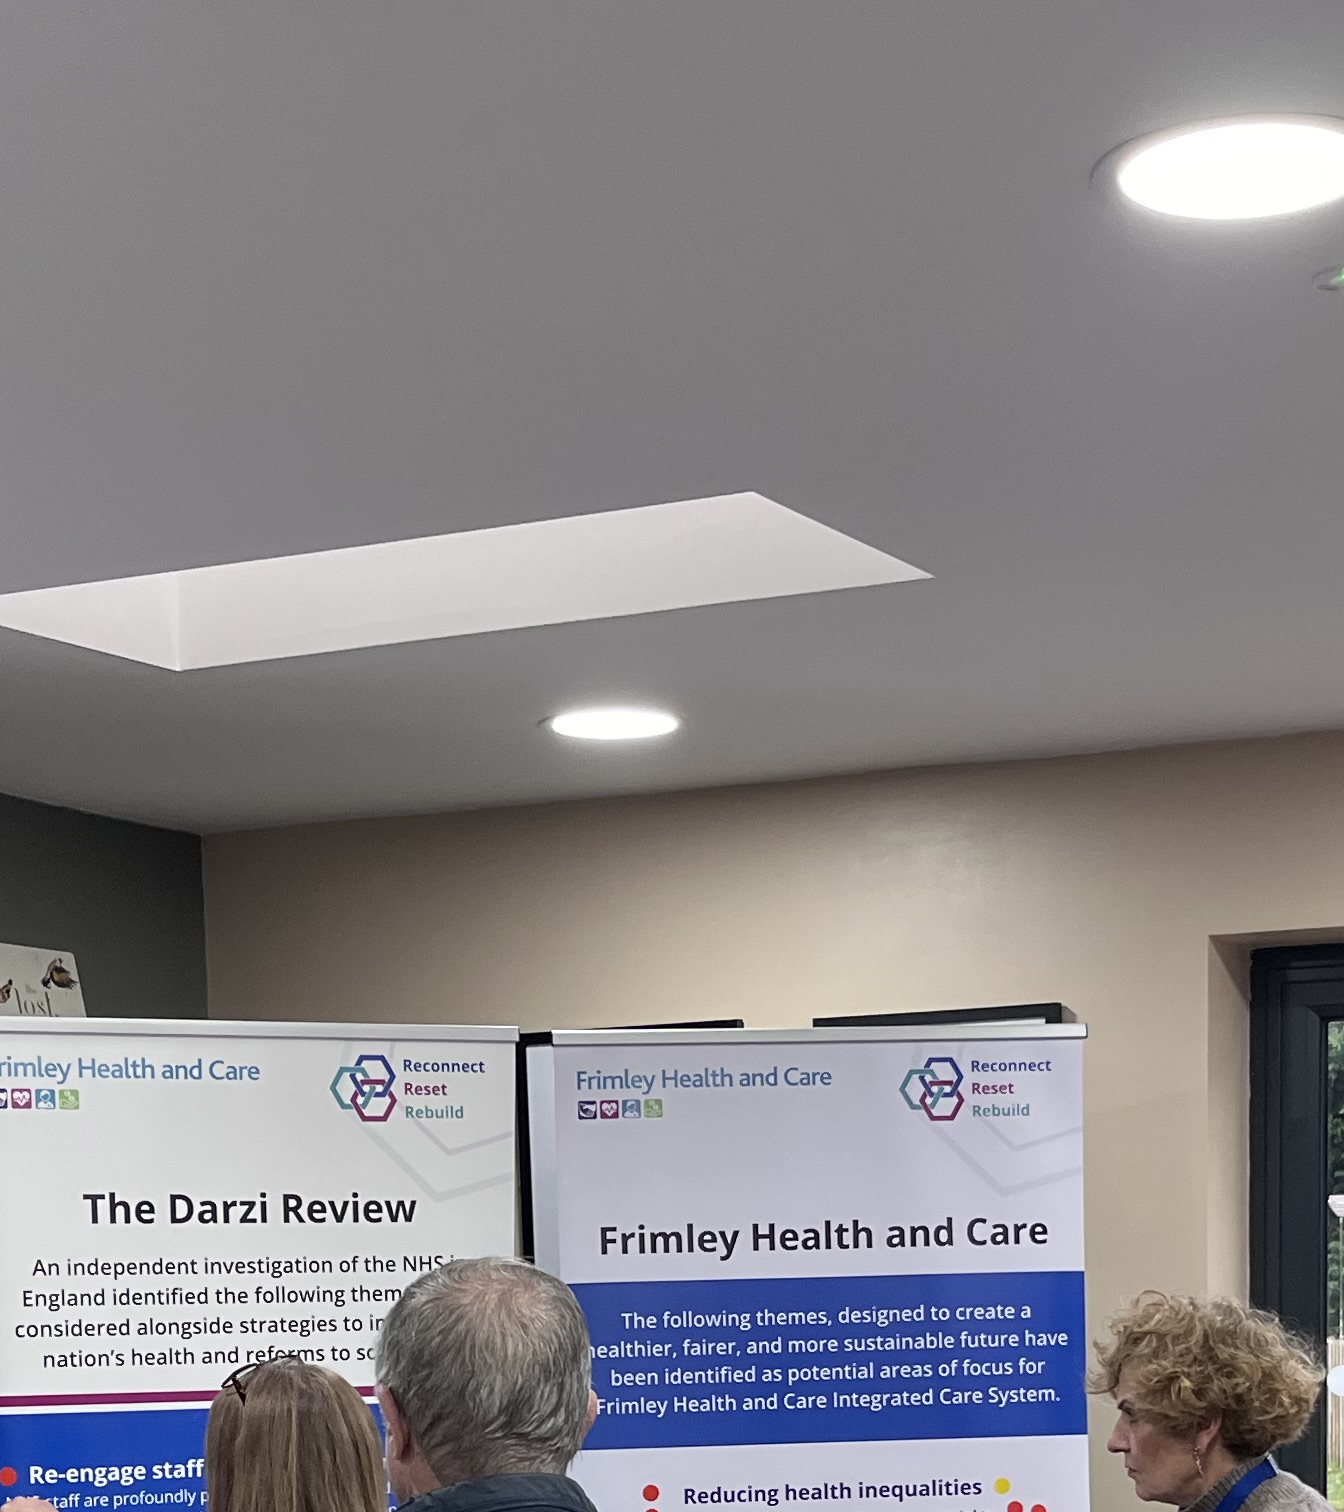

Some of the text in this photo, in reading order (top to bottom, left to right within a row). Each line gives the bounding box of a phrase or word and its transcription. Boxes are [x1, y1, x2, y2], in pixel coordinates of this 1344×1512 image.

[77, 1056, 156, 1080] Health
[161, 1057, 203, 1081] and
[208, 1059, 261, 1081] Care
[403, 1059, 486, 1074] Reconnect
[970, 1059, 1052, 1073] Reconnect
[404, 1082, 448, 1096] Reset
[576, 1065, 833, 1096] Frimley Health and Care
[971, 1082, 1015, 1095] Reset
[405, 1105, 464, 1120] Rebuild
[972, 1103, 1030, 1118] Rebuild
[82, 1191, 417, 1225] The Darzi Review
[600, 1216, 1048, 1262] Frimley Health and Care
[32, 1255, 446, 1281] An independent investigation of the NHS
[22, 1285, 346, 1312] England identified the following
[15, 1315, 363, 1340] considered alongside strategies to
[620, 1304, 1032, 1331] The following themes, designed to create a
[131, 1347, 195, 1366] health
[201, 1346, 239, 1365] and
[29, 1458, 205, 1488] Re-engage staff
[684, 1478, 983, 1507] Reducing health inequalities
